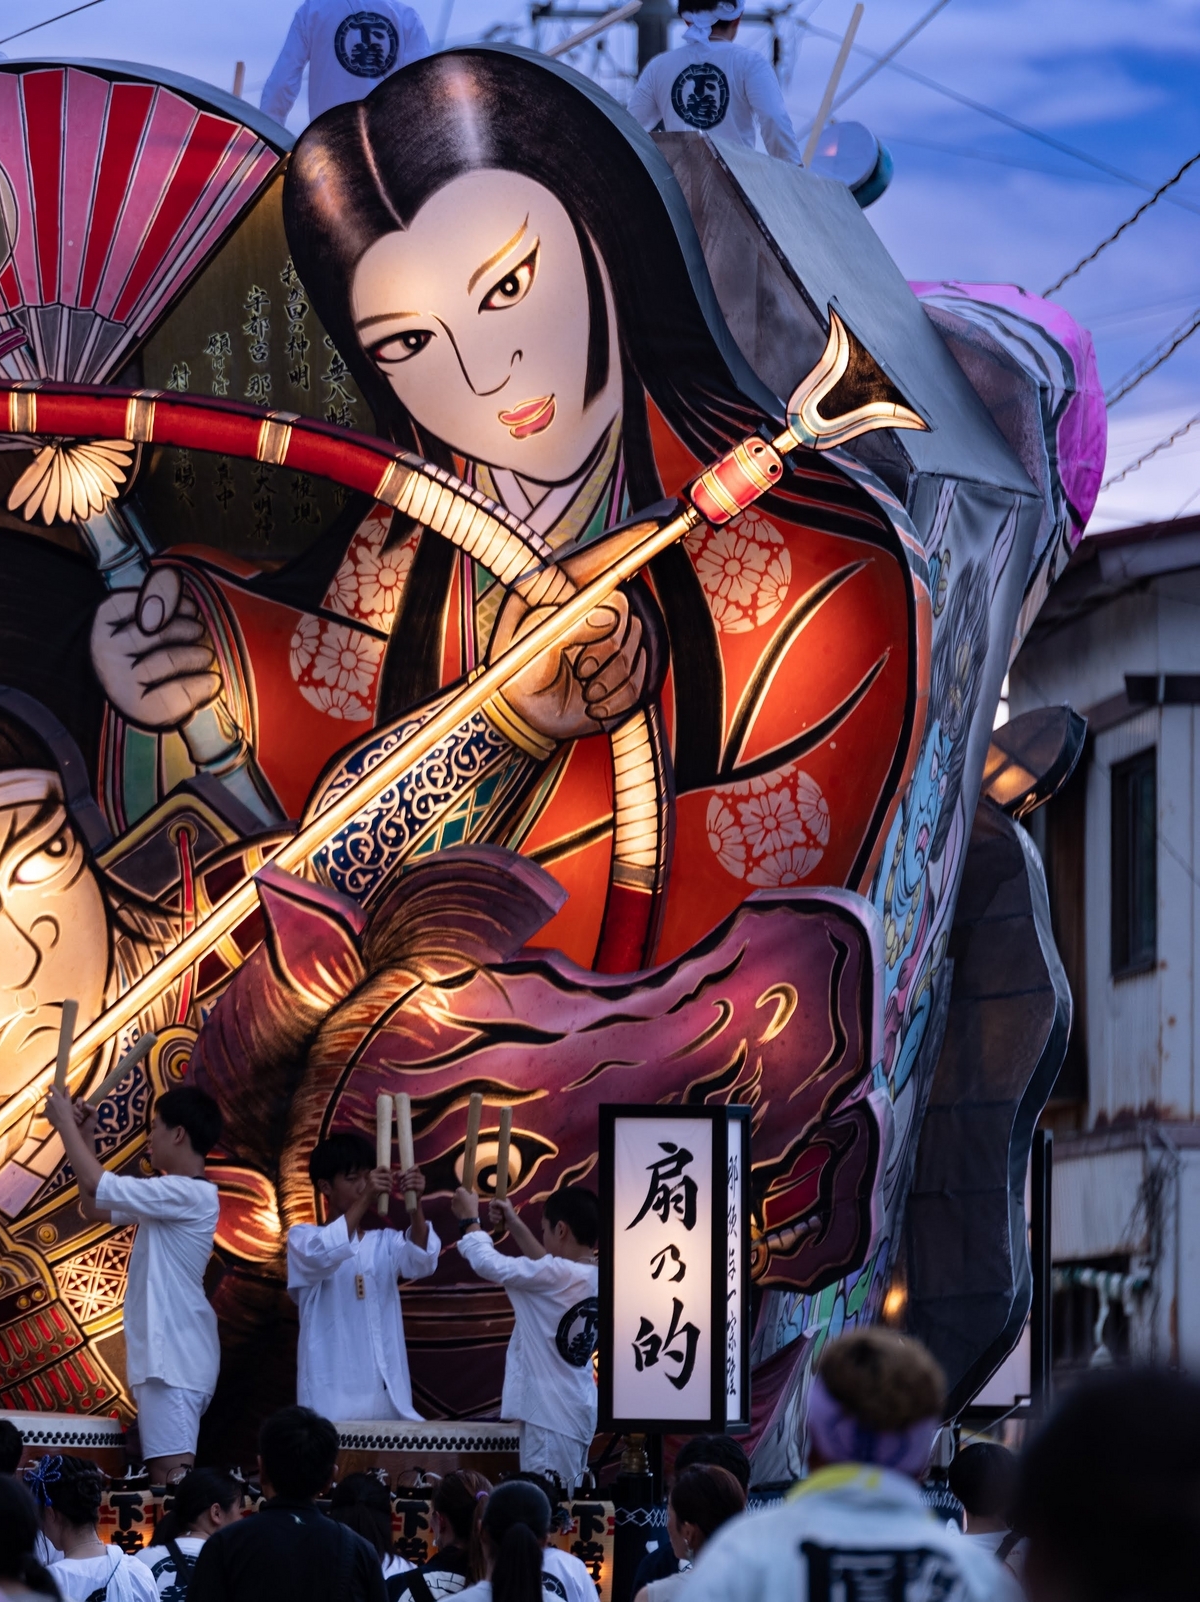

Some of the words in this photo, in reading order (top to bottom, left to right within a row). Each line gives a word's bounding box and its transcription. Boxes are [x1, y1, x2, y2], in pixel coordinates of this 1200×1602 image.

[243, 284, 271, 363] 宇都宮
[320, 335, 358, 428] 無八幡
[211, 455, 237, 511] 真中
[624, 1141, 700, 1390] 扇乃的
